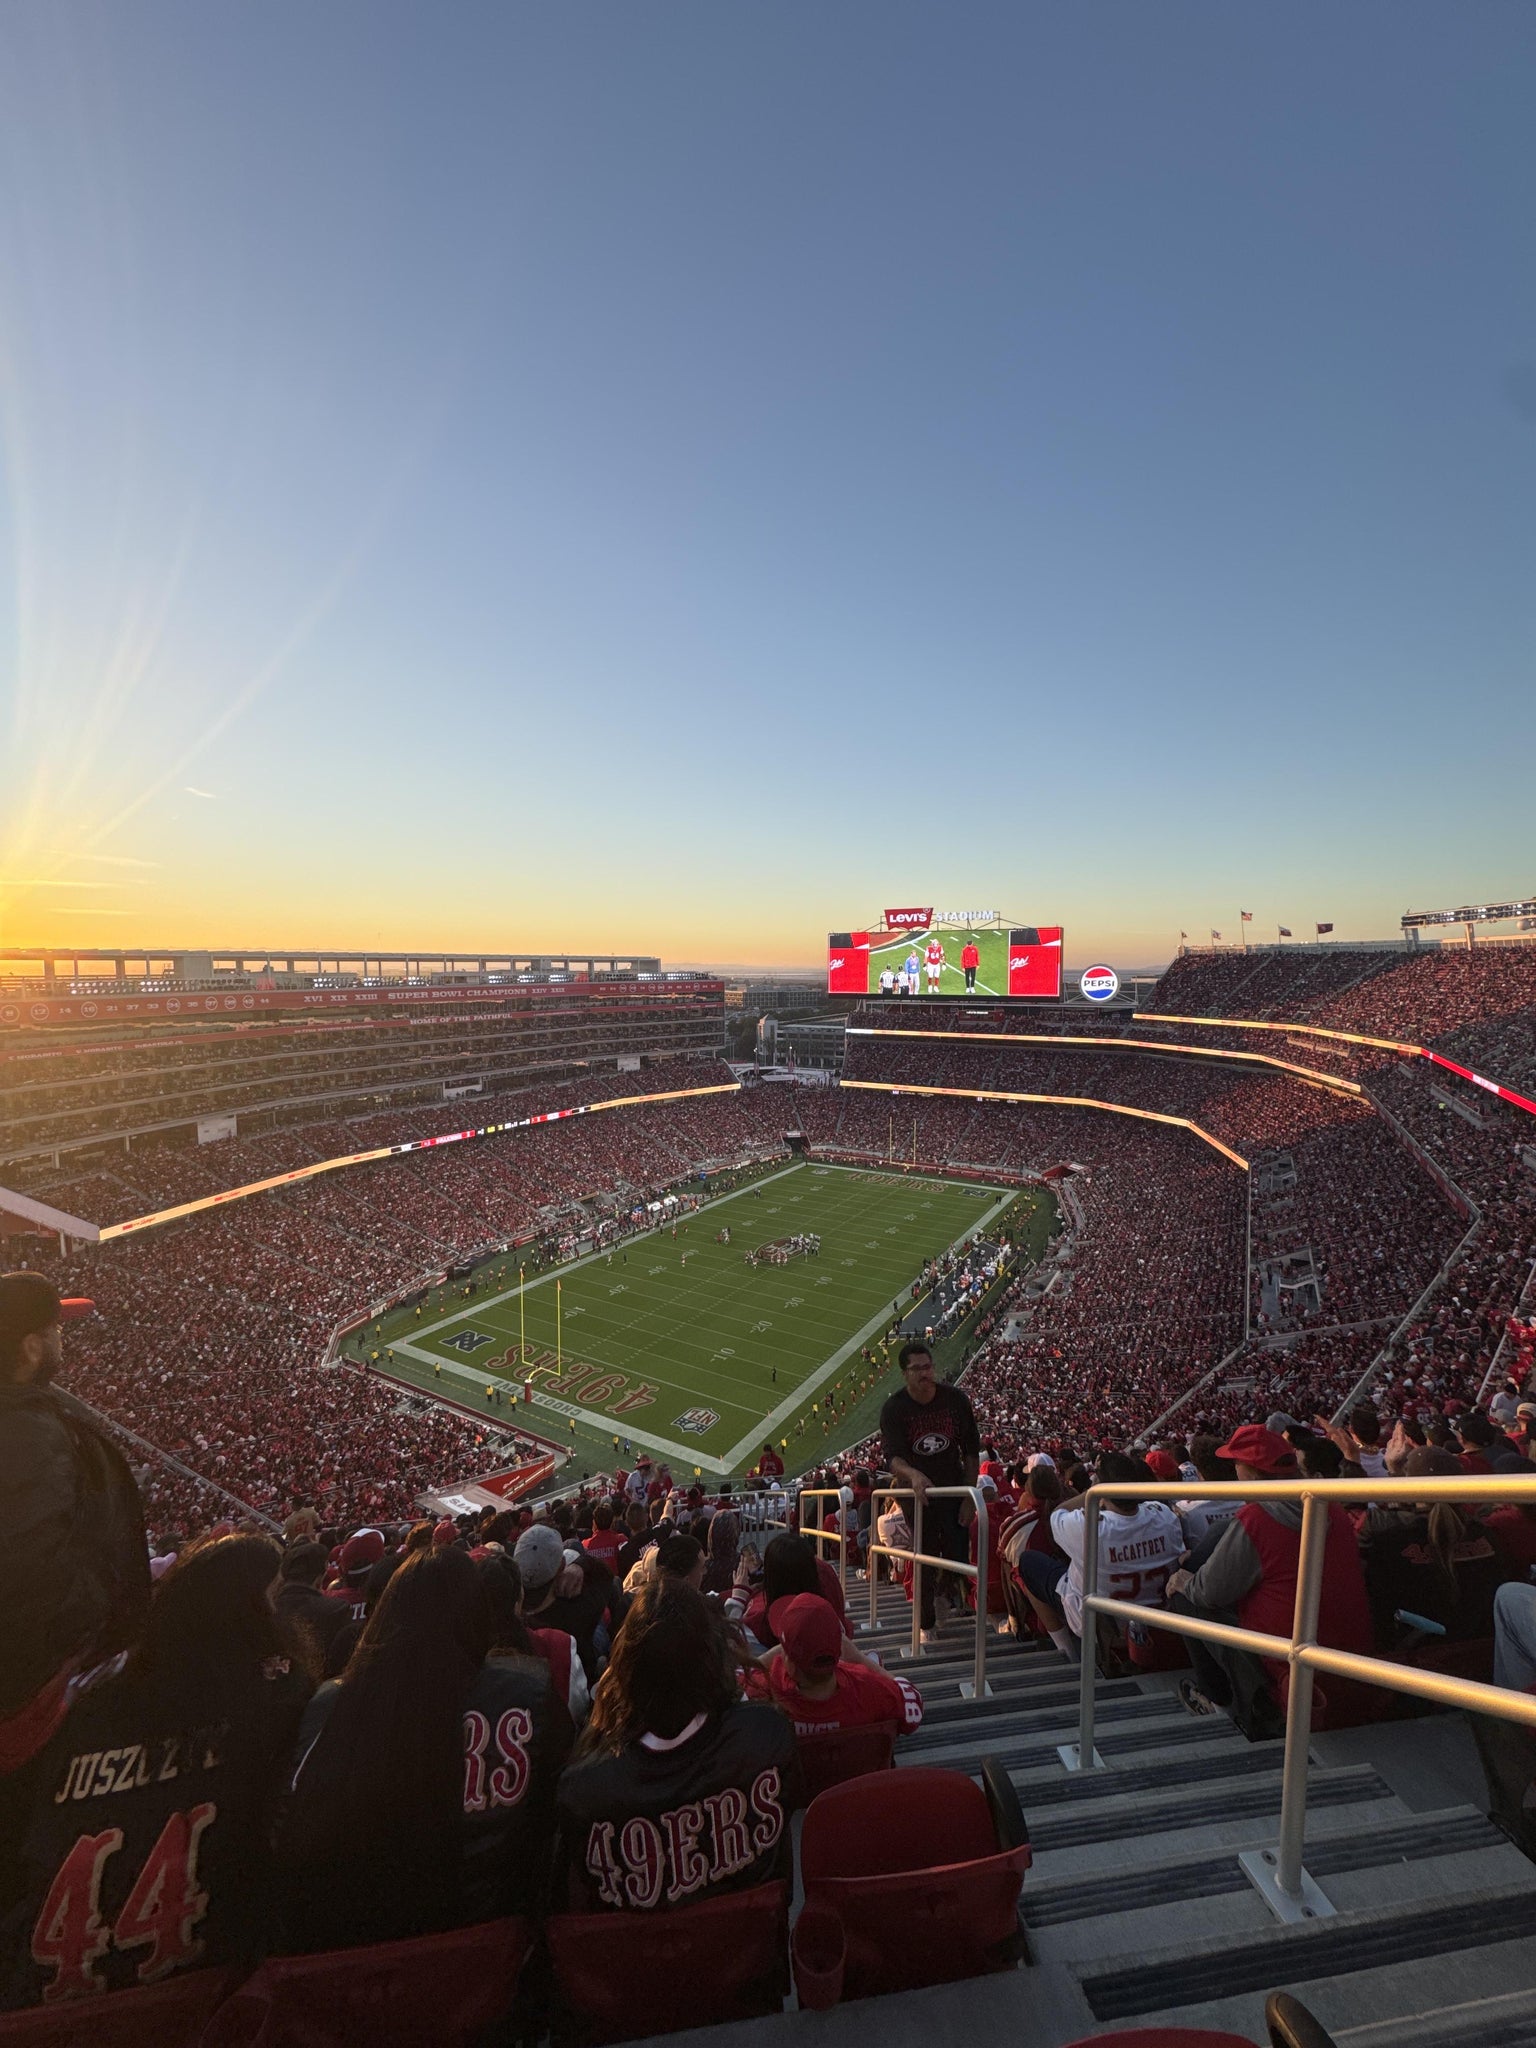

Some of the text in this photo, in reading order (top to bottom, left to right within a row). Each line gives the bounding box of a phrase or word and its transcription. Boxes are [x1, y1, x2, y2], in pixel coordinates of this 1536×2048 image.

[936, 911, 994, 922] STADIUM
[303, 995, 323, 1003] XVI
[355, 993, 378, 1001] XXIII
[387, 991, 429, 1000] SUPER
[432, 990, 465, 998] BOWL
[467, 988, 528, 997] CHAMPIONS
[473, 1013, 512, 1021] FAITHFUL
[484, 1343, 660, 1415] 49ERS
[689, 1408, 718, 1425] NFL
[1108, 1534, 1167, 1564] McCAFFREY
[586, 1765, 784, 1908] 49ERS
[31, 1801, 217, 2004] 44
